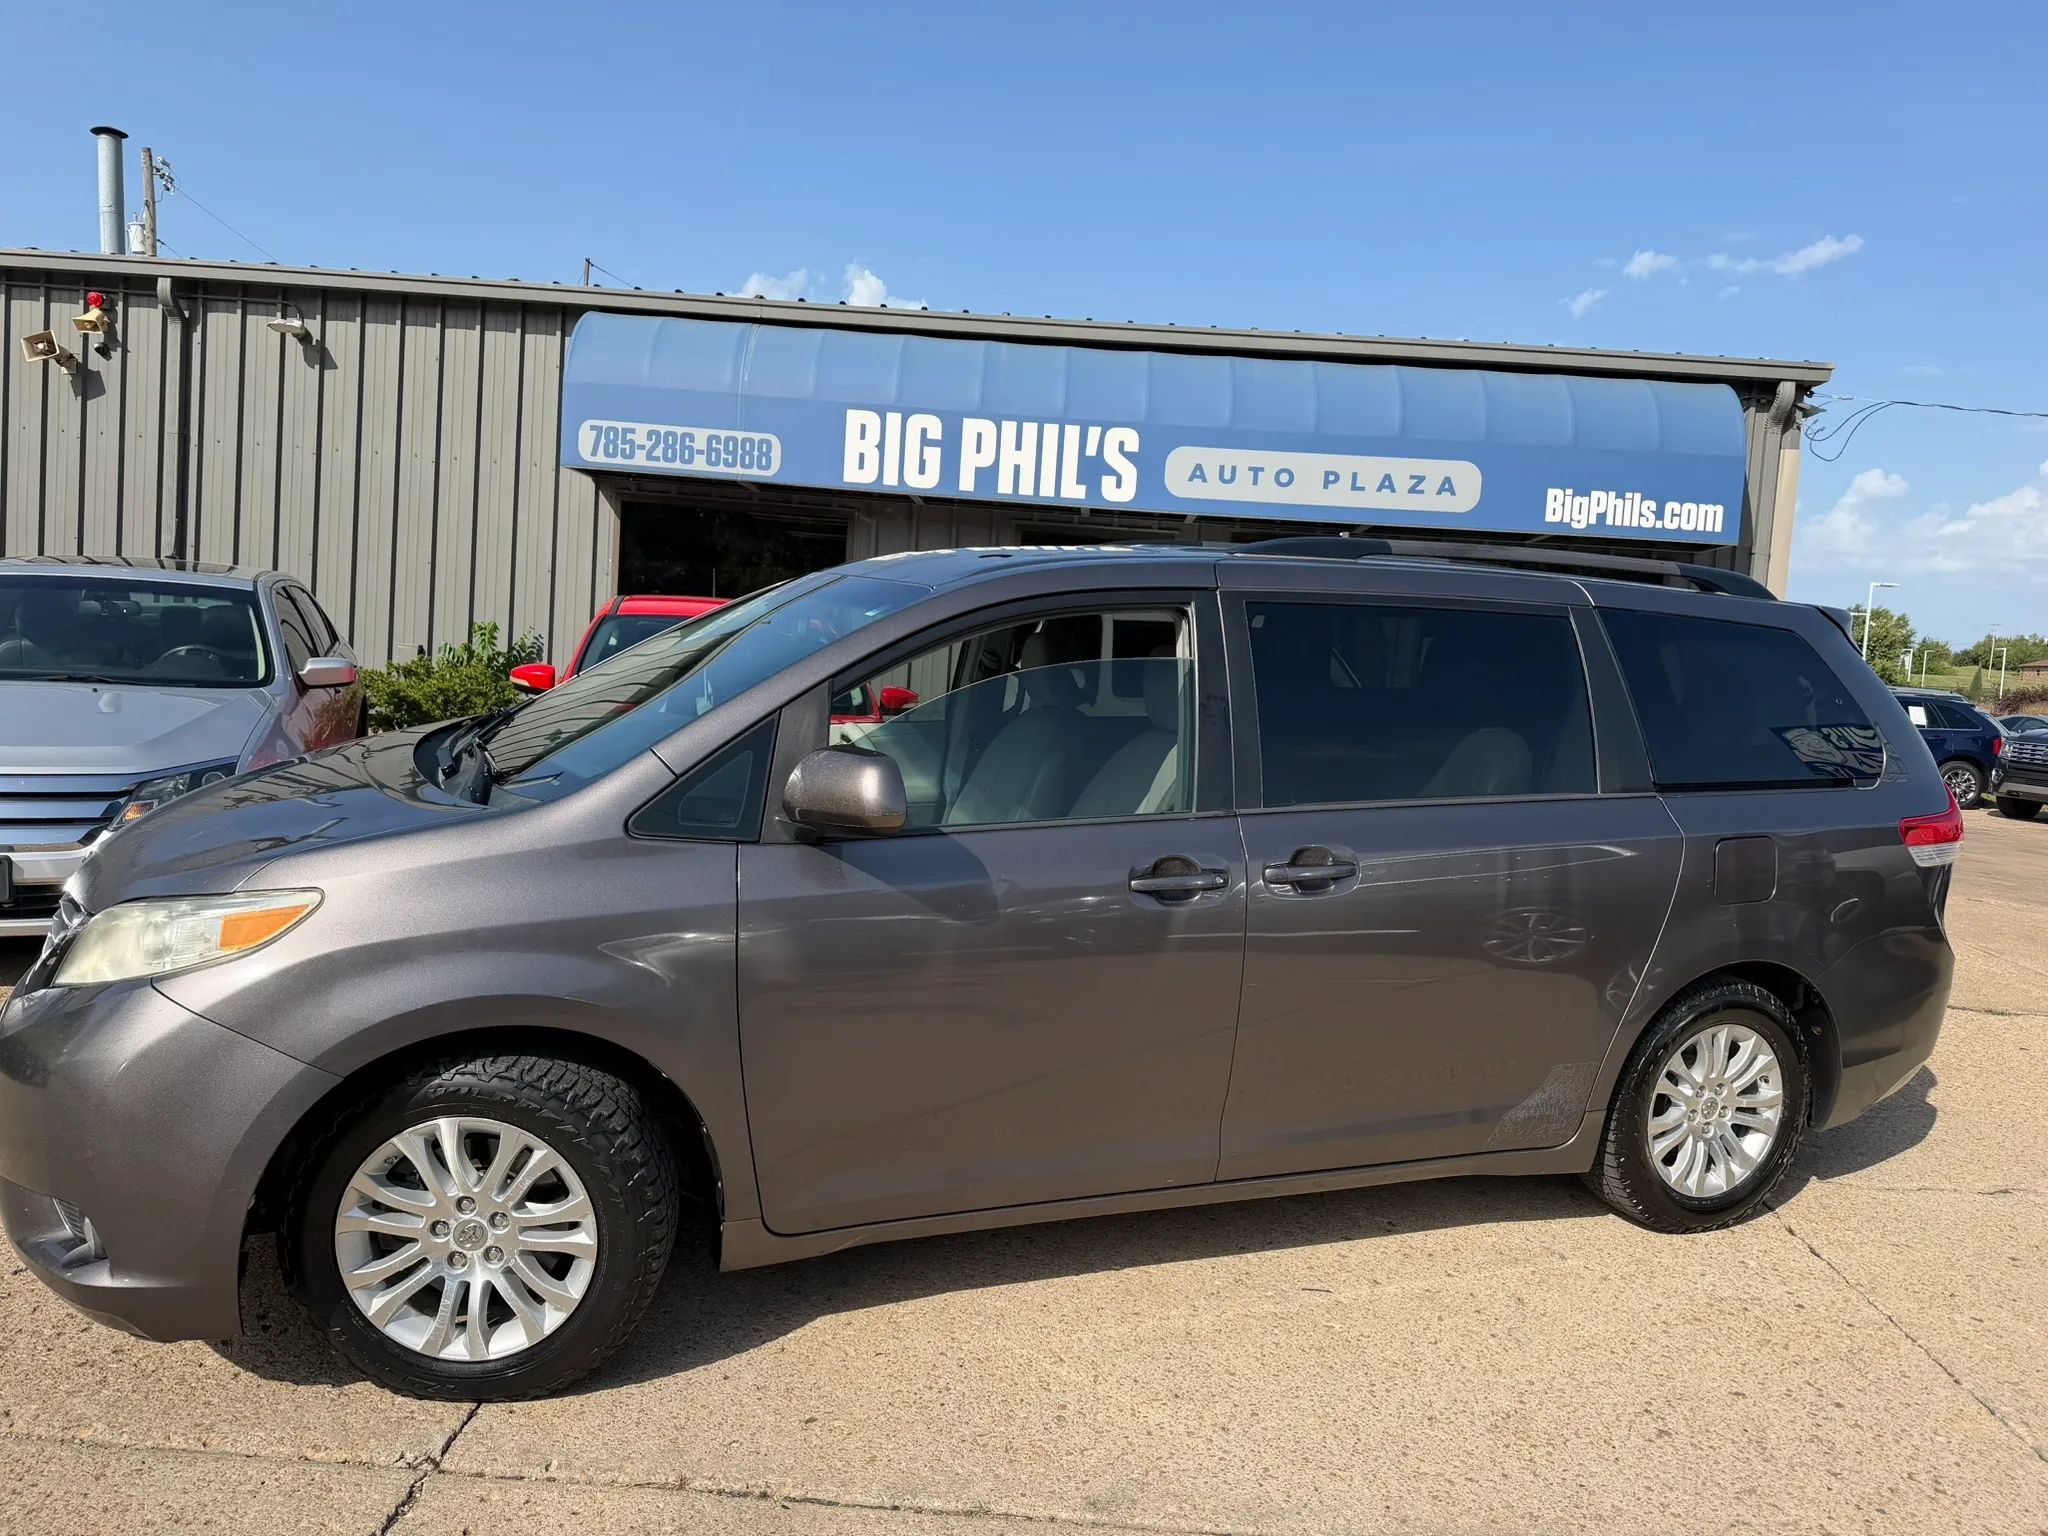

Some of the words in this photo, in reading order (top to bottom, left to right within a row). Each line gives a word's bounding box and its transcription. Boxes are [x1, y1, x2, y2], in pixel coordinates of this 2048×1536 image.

[589, 425, 773, 471] 785-286-6988
[843, 409, 943, 489] BIG
[958, 418, 1140, 502] PHIL'S
[1187, 463, 1295, 488] AUTO
[1323, 470, 1457, 496] PLAZA
[1545, 487, 1723, 532] BigPhils.com
